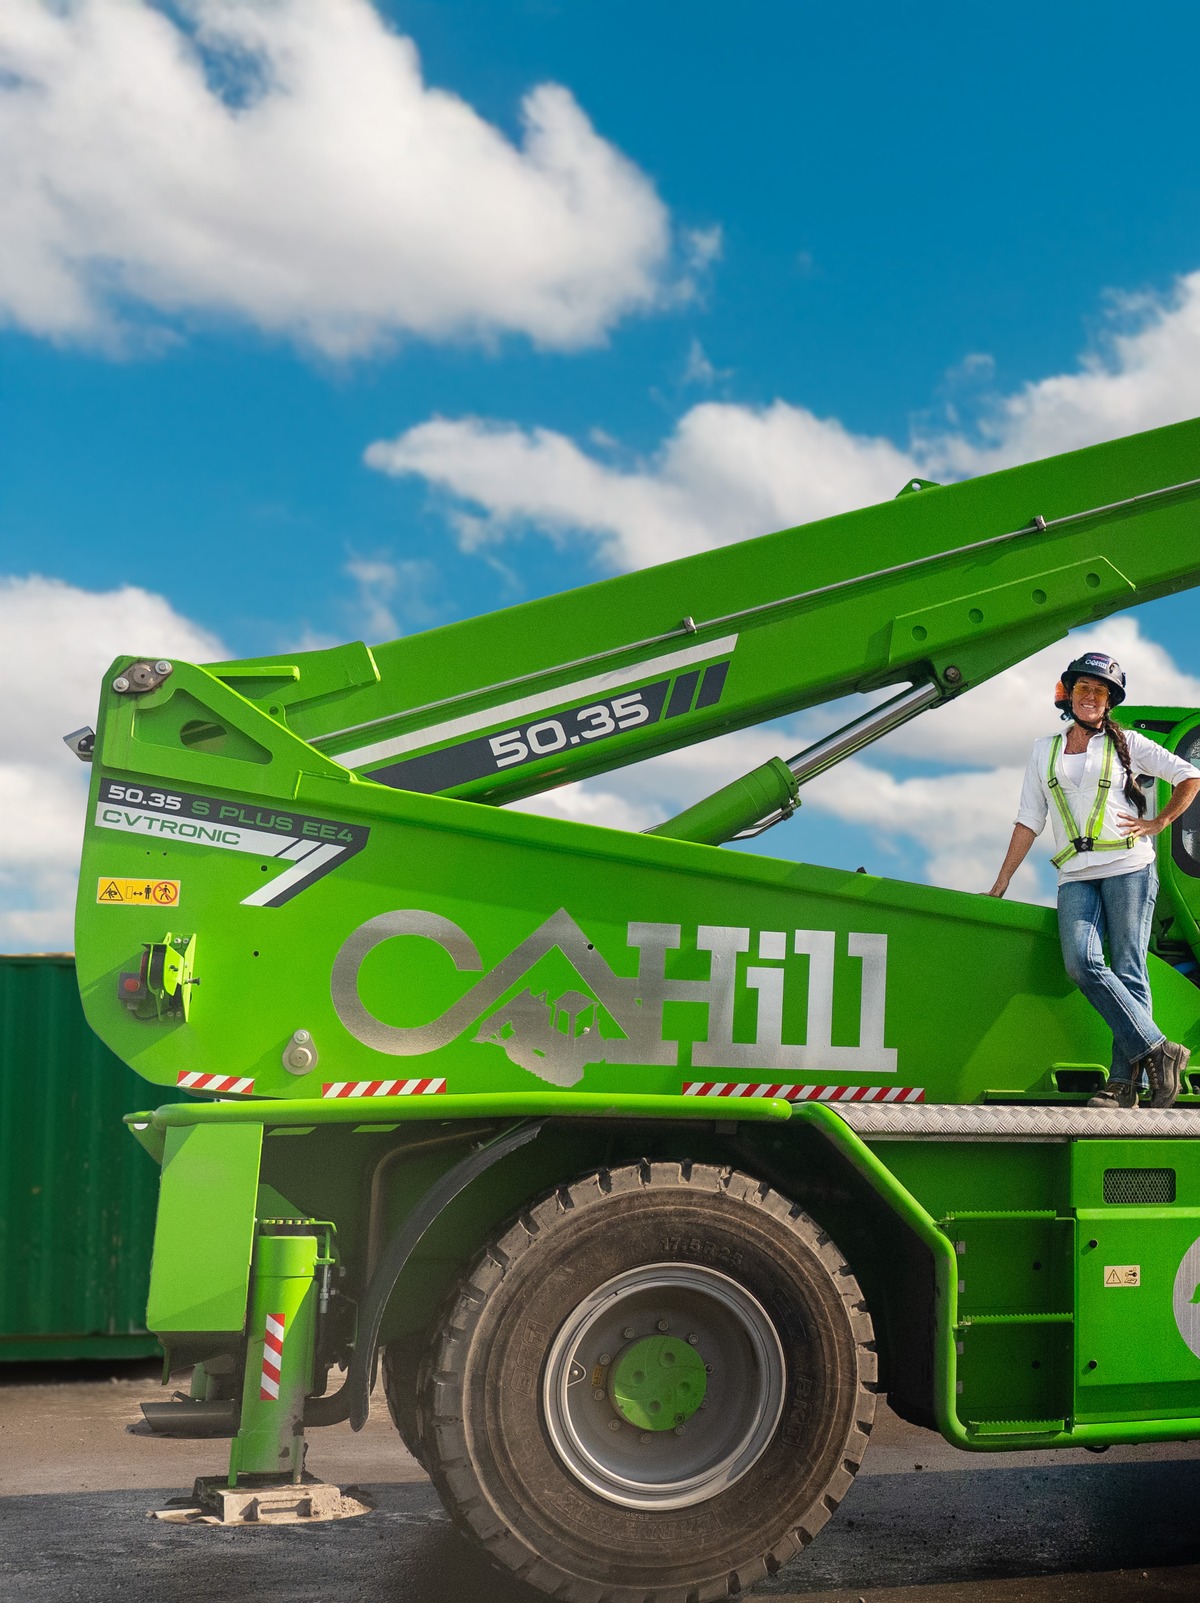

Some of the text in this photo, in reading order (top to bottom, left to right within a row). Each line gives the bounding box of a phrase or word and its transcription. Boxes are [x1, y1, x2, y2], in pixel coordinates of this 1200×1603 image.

[488, 692, 650, 768] 50.35
[102, 809, 242, 846] CVTRONIC
[108, 784, 354, 843] 50.35 S PLUS EE4
